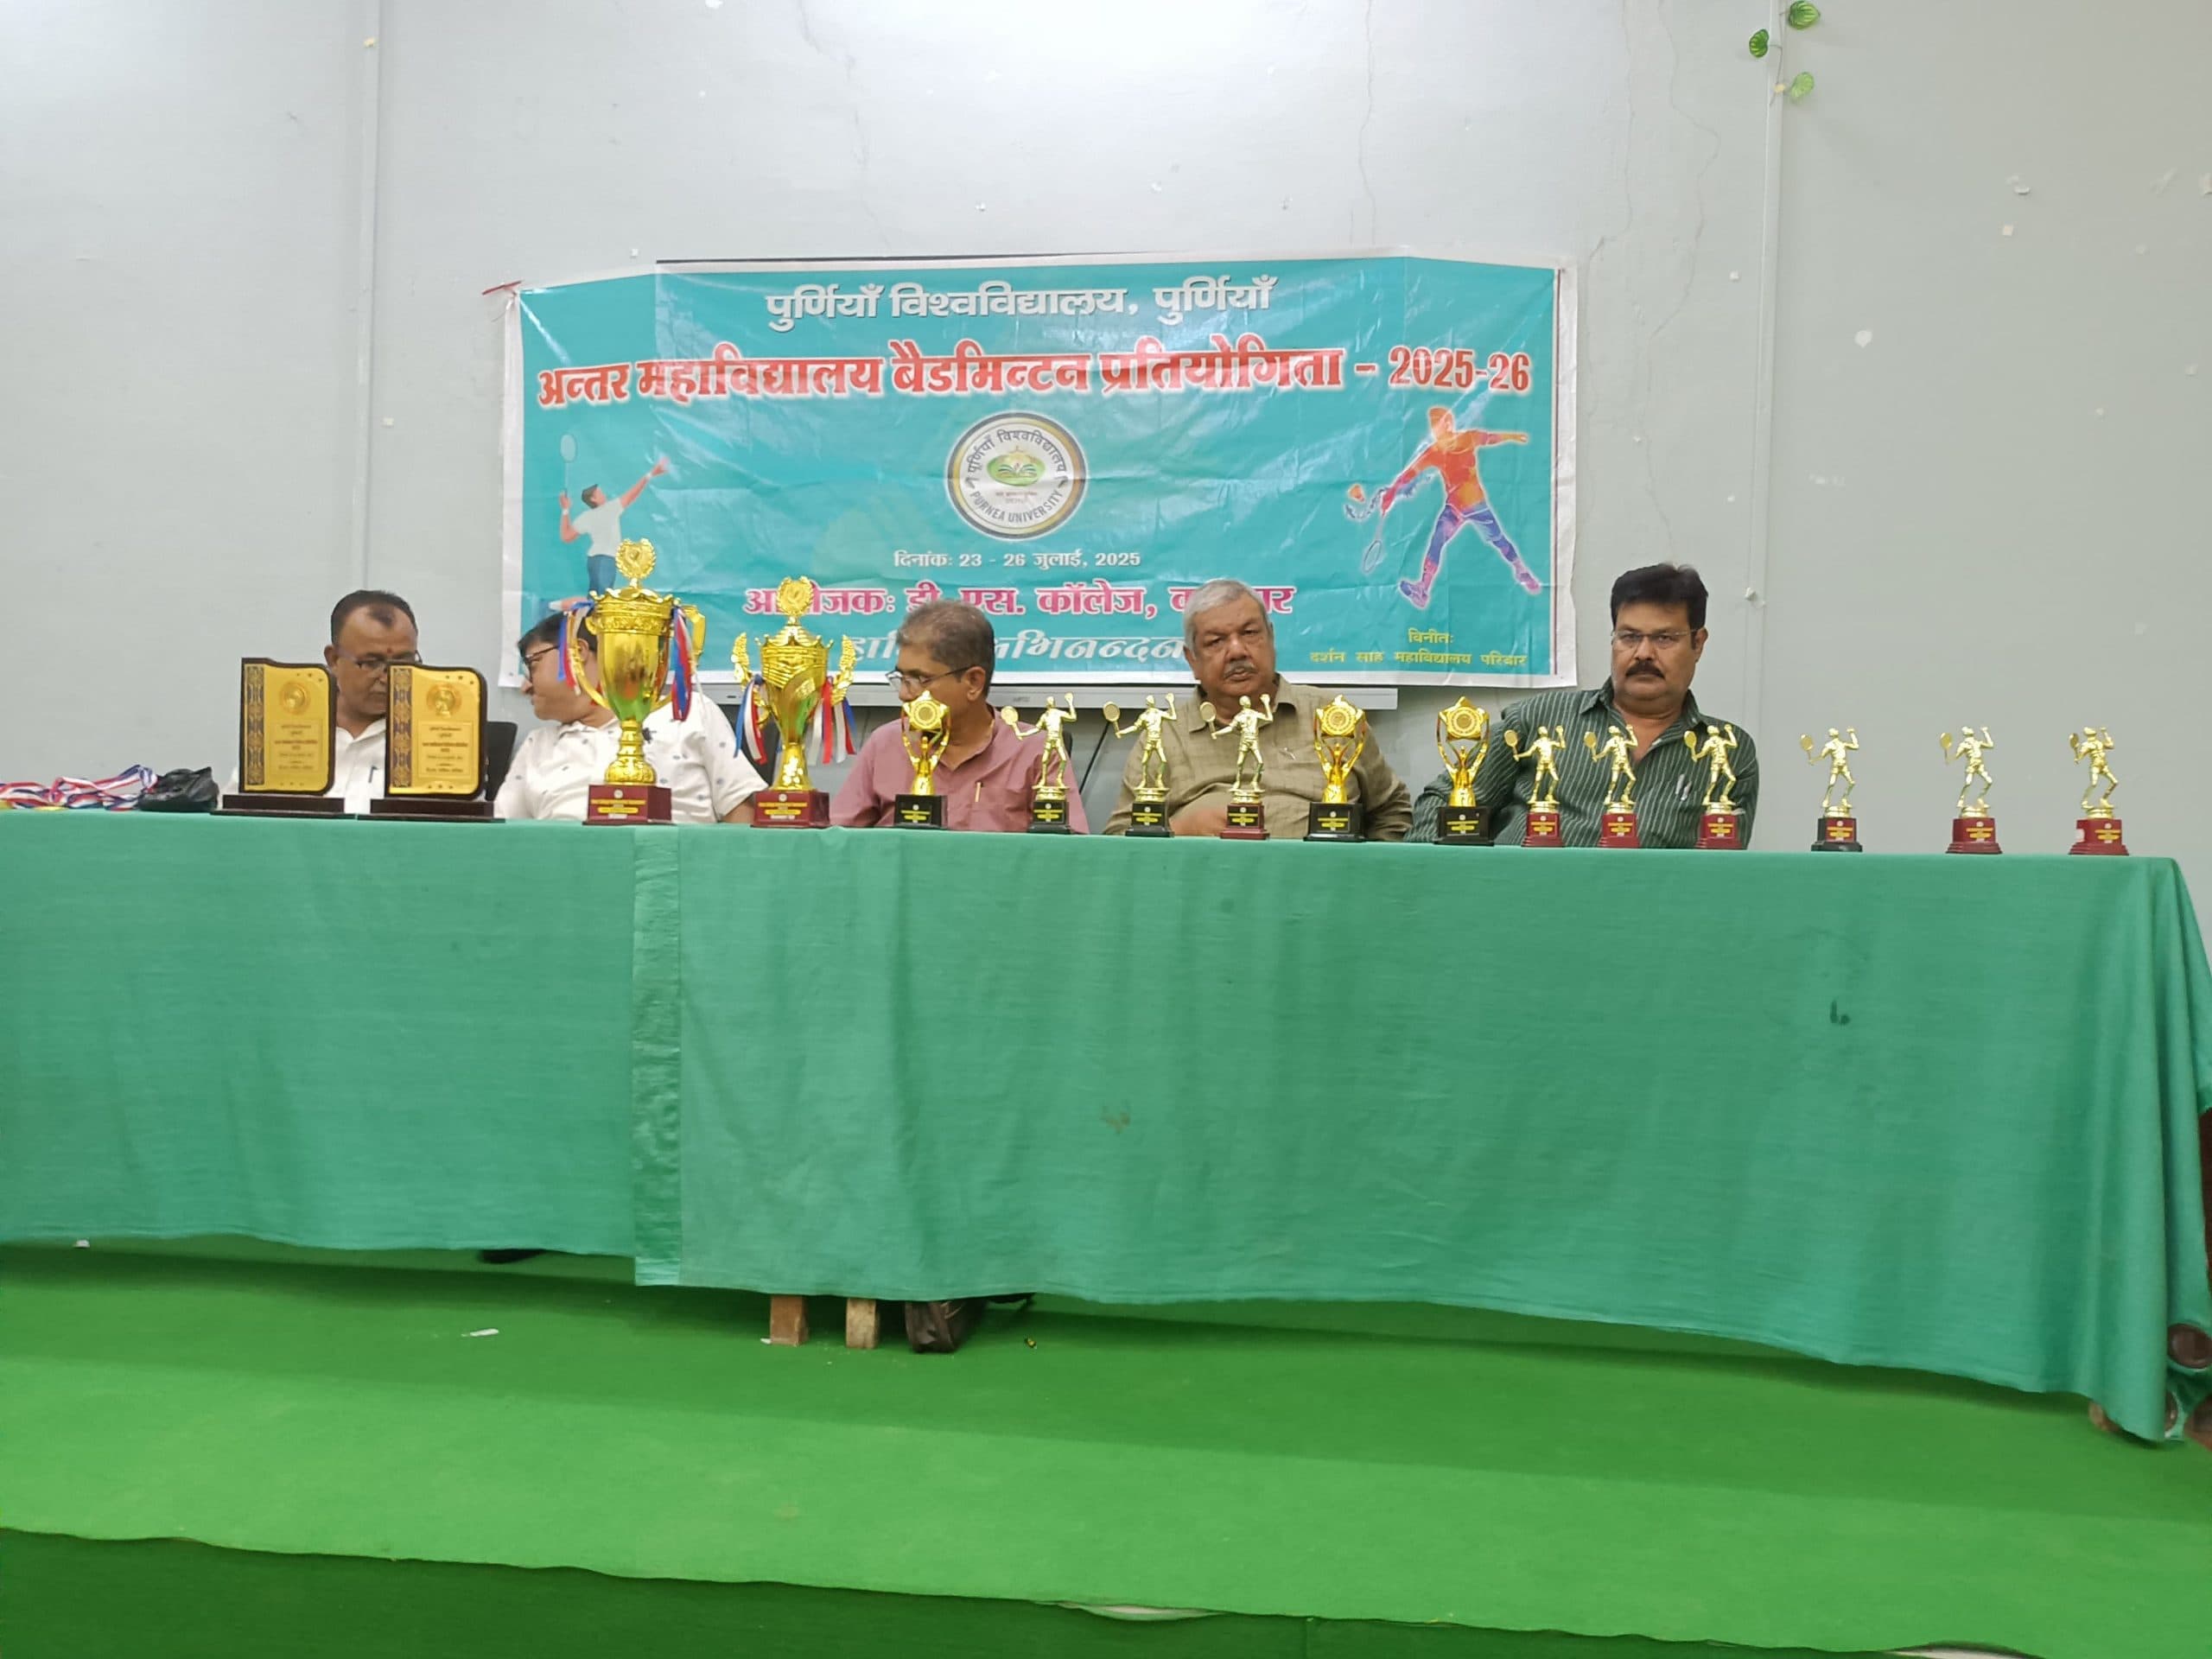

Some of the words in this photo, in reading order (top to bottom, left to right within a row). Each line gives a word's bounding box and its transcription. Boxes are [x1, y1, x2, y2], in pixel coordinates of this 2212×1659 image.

[889, 280, 1139, 318] विश्वविद्यालय,
[537, 363, 632, 406] अन्तर
[636, 342, 884, 403] महाविद्यालय
[889, 340, 1091, 394] बैडमिन्टन
[1098, 334, 1344, 394] प्रतियोगिता
[1389, 346, 1530, 391] 2025-26
[969, 490, 1006, 522] PURNEA
[1007, 489, 1064, 524] UNIVERSITY
[959, 553, 982, 567] 23
[1003, 553, 1026, 567] 26
[1095, 552, 1141, 567] 2025
[1036, 579, 1157, 619] कॉलेज,
[1310, 648, 1346, 664] दर्शन
[1394, 648, 1473, 664] महाविद्यालय
[1479, 650, 1529, 666] परिवार
